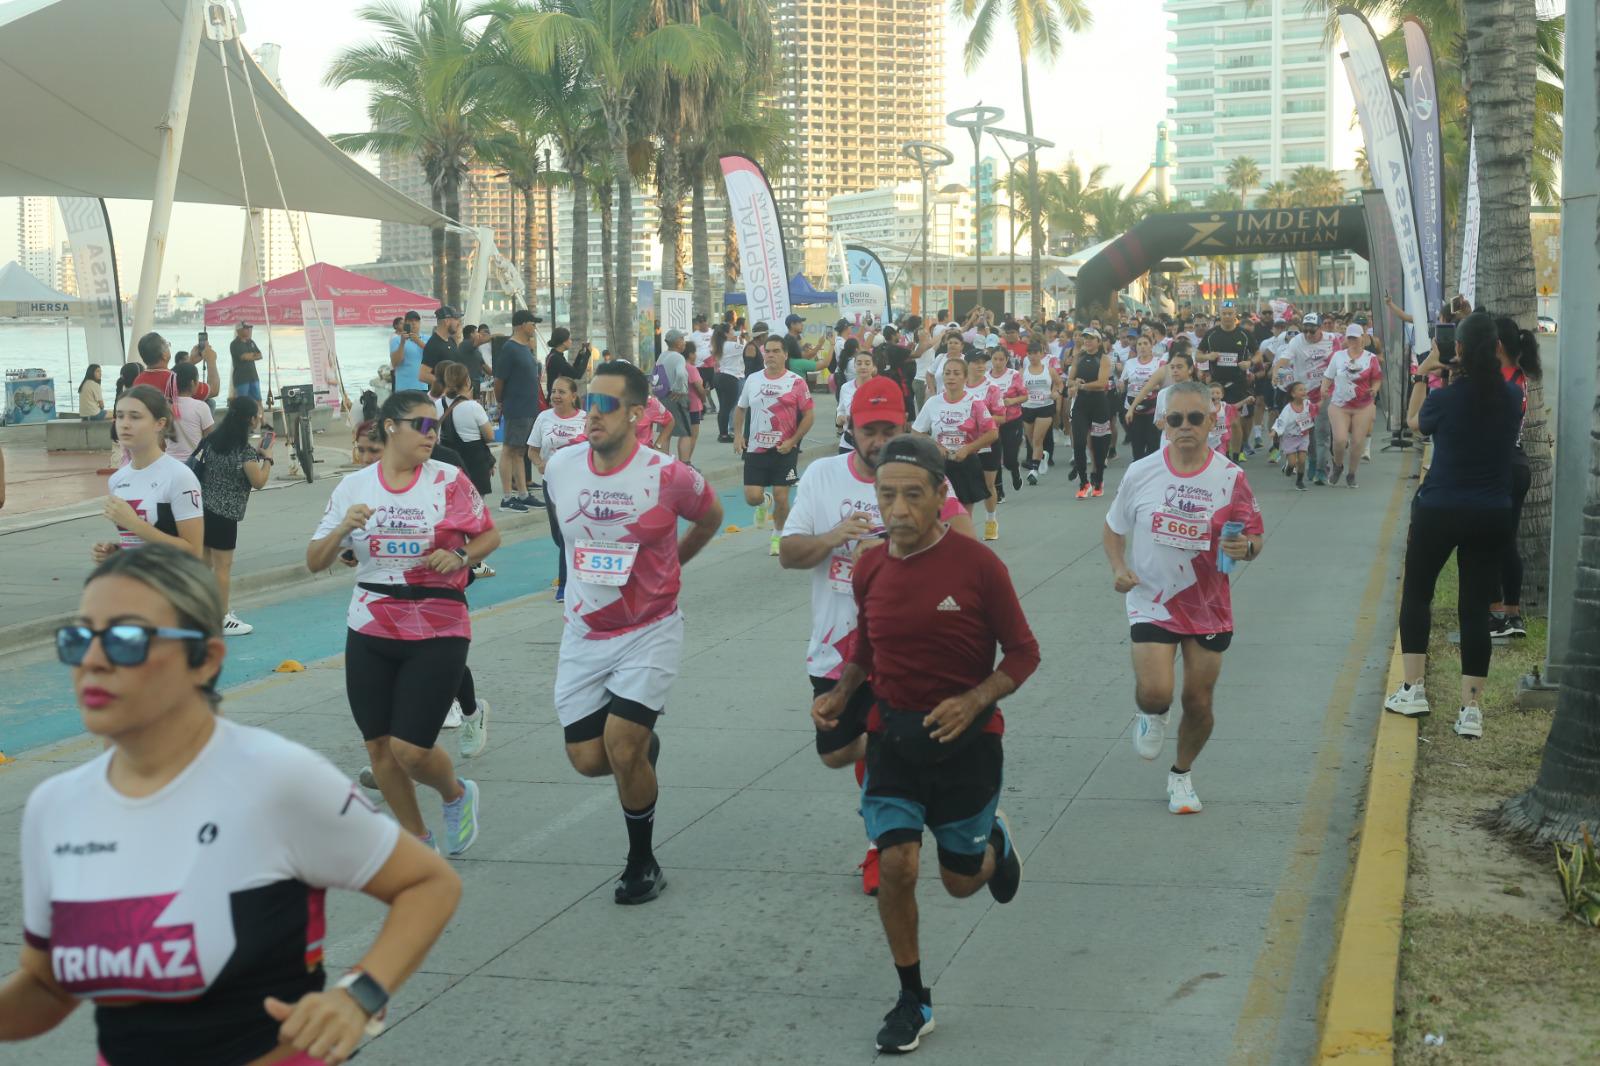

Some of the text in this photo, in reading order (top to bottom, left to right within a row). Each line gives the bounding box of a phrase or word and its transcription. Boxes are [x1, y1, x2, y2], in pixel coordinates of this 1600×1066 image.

[1236, 208, 1340, 231] IMDEM
[737, 196, 771, 322] HOSPITAL
[771, 272, 784, 319] SHARP
[31, 303, 69, 312] HERSA
[1168, 521, 1198, 537] 666
[387, 541, 420, 555] 610
[591, 555, 624, 571] 531
[51, 937, 197, 983] TRIMAZ
